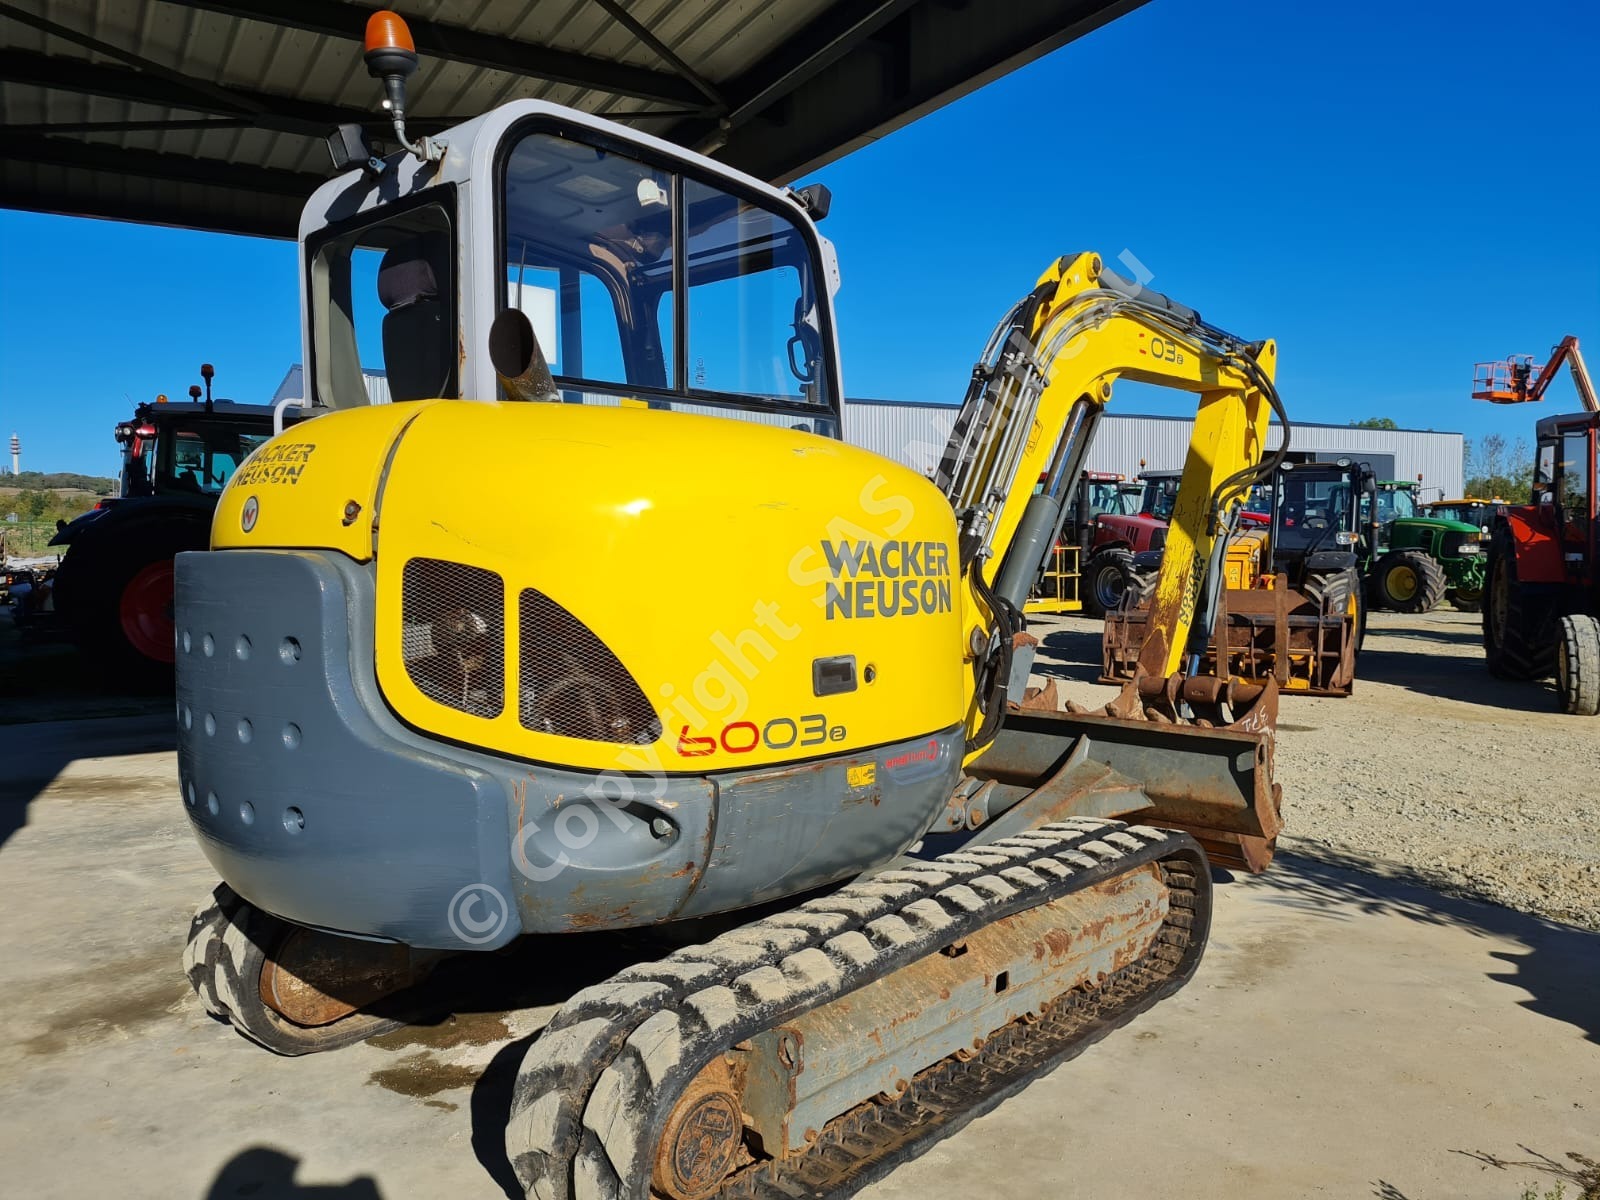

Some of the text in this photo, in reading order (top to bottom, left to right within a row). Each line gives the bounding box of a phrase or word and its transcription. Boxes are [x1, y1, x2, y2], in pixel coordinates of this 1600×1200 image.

[246, 443, 316, 467] WACKER
[232, 464, 305, 488] NEUSON
[820, 539, 950, 578] WACKER
[825, 579, 952, 620] NEUSON
